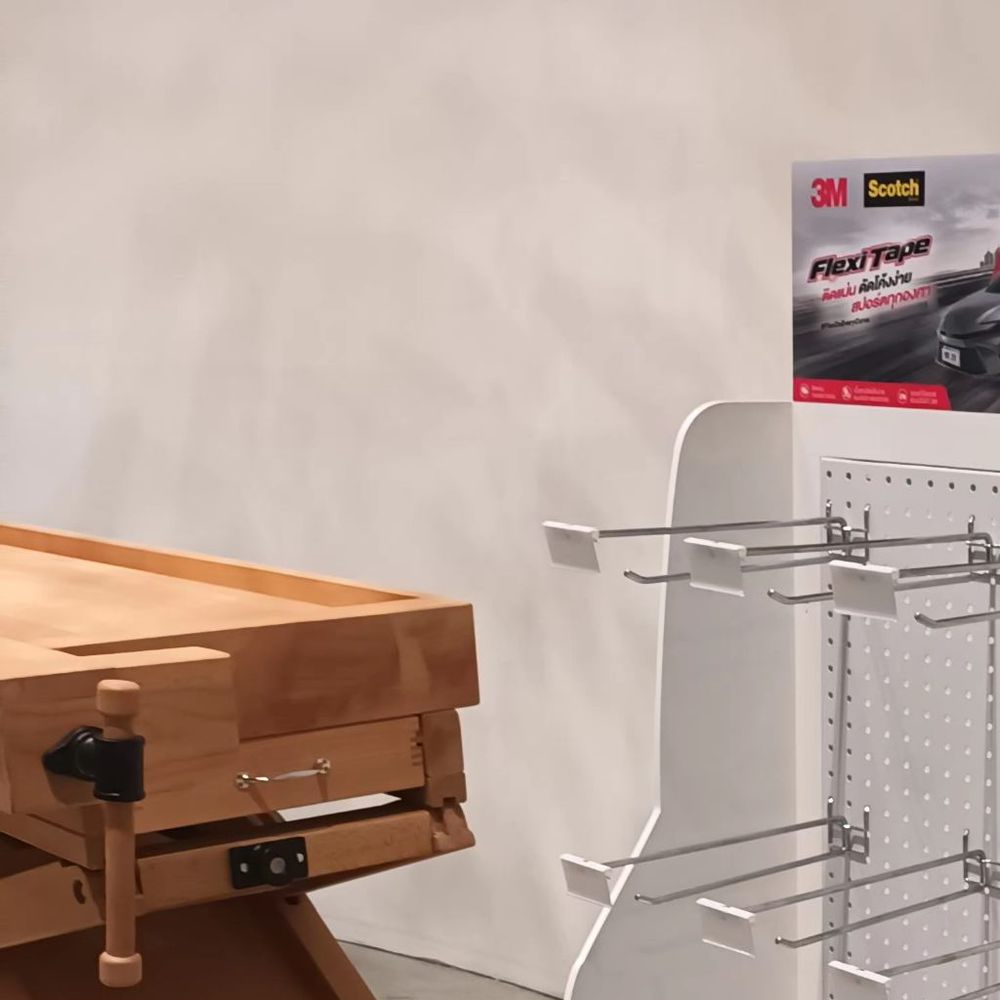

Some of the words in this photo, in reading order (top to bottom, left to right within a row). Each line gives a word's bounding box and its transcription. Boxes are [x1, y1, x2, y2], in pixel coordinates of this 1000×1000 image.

[810, 177, 848, 208] 3M
[868, 178, 919, 198] Scotch
[807, 250, 868, 283] Flexi
[866, 234, 934, 272] Tape
